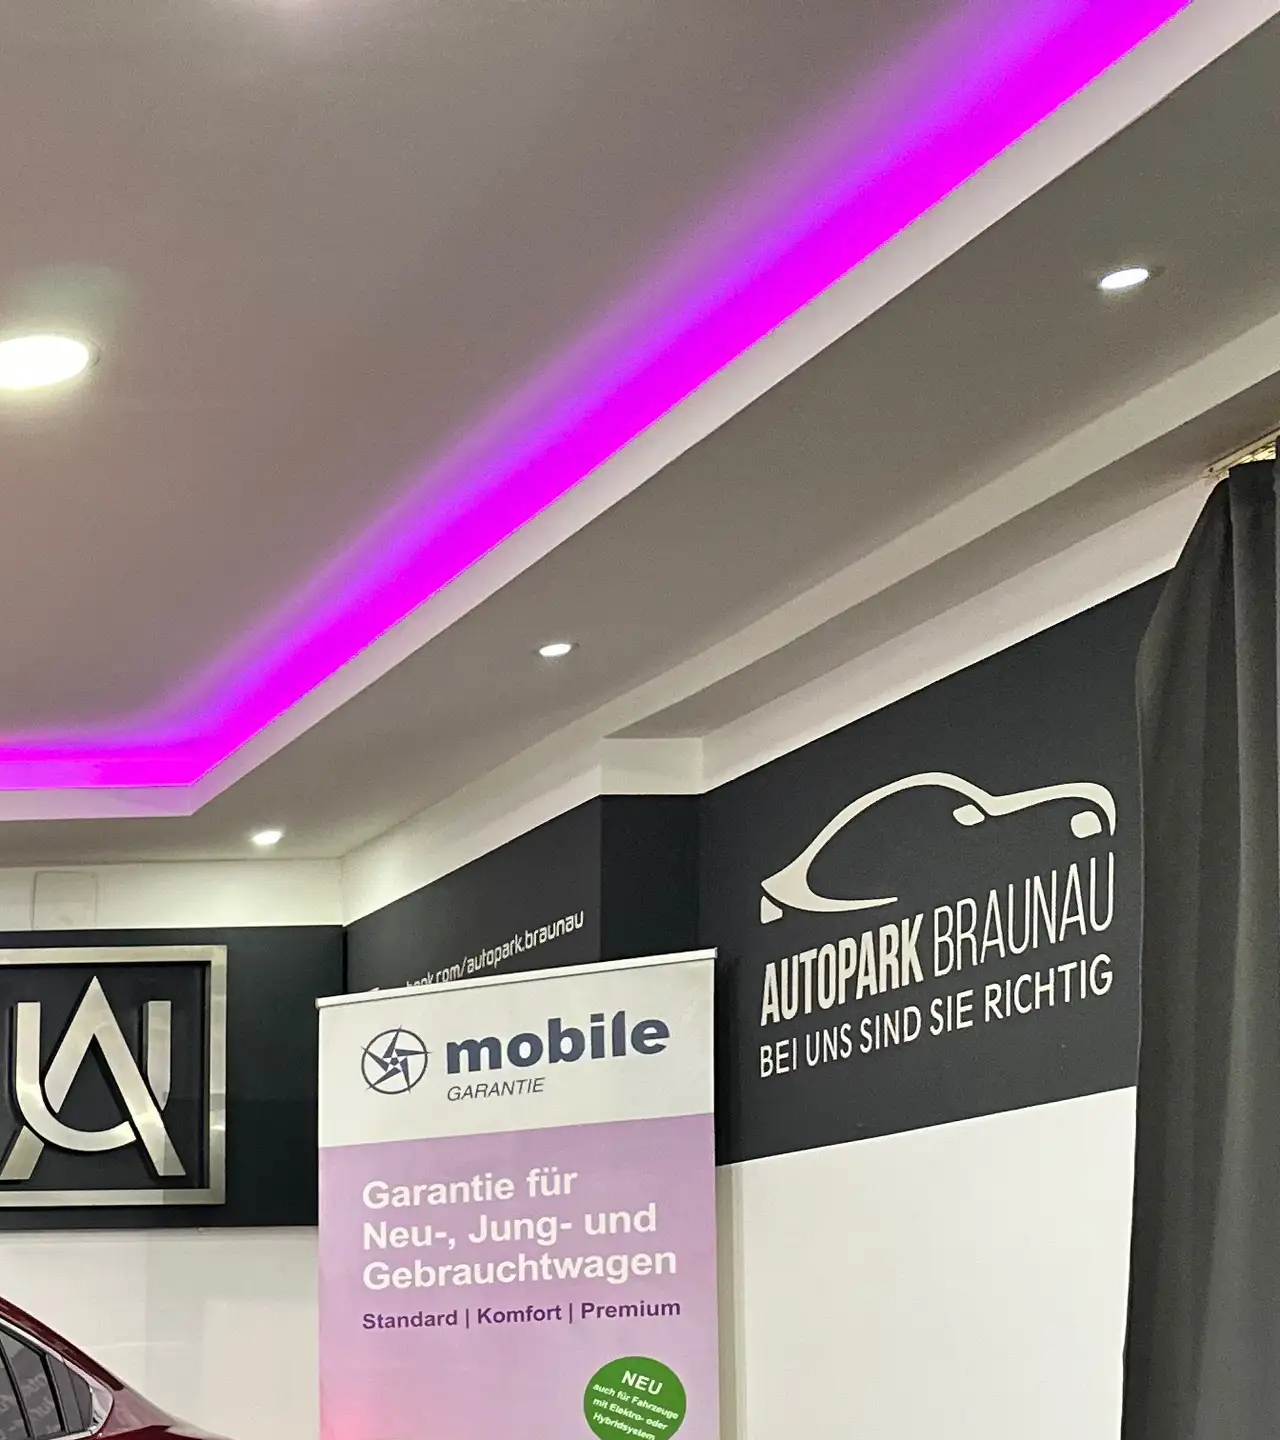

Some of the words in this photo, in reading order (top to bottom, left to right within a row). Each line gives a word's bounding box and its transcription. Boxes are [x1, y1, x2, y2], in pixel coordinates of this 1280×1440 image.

[760, 913, 924, 1026] AUTOPARK
[933, 851, 1115, 977] BRAUNAU
[760, 1037, 798, 1079] BEI
[806, 1023, 853, 1067] UNS
[859, 1005, 922, 1054] SIND
[929, 989, 974, 1037] SIE
[984, 953, 1114, 1023] RICHTIG
[446, 1010, 670, 1075] mobile
[447, 1076, 546, 1102] GARANTIE
[362, 1172, 515, 1210] Garantie
[526, 1166, 578, 1198] für
[363, 1220, 456, 1251] Neu-,
[468, 1214, 572, 1248] Jung-
[584, 1202, 657, 1236] und
[362, 1250, 677, 1291] Gebrauchtwagen
[362, 1309, 458, 1330] Standard
[477, 1304, 562, 1325] Komfort
[581, 1300, 681, 1320] Premium
[593, 1383, 616, 1396] auch
[617, 1390, 631, 1402] für
[631, 1396, 679, 1420] Fahrzeuge
[621, 1370, 663, 1395] NEU
[592, 1398, 609, 1409] mit
[645, 1418, 668, 1431] oder
